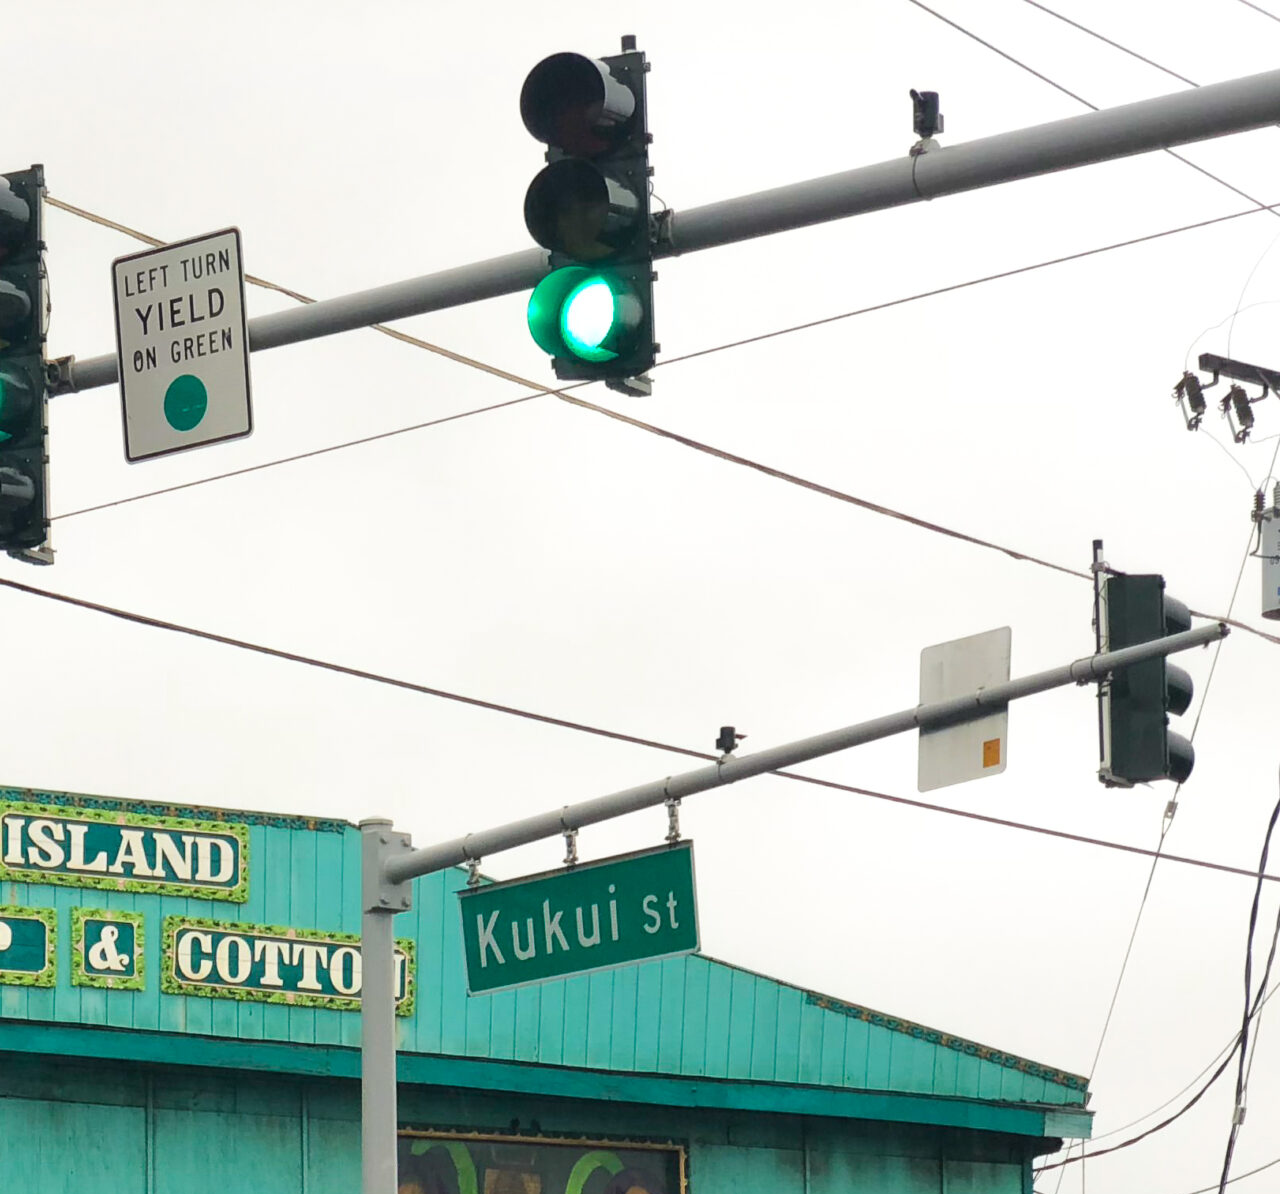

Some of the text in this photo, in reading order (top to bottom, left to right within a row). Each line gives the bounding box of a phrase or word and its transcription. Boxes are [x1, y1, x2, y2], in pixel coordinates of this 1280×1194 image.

[125, 249, 230, 297] LEFT TURN
[135, 288, 225, 335] YIELD
[133, 327, 233, 372] ON GREEN
[3, 816, 234, 883] ISLAND
[476, 884, 679, 968] Kukui St
[88, 925, 130, 971] &
[177, 931, 404, 998] COTTO
